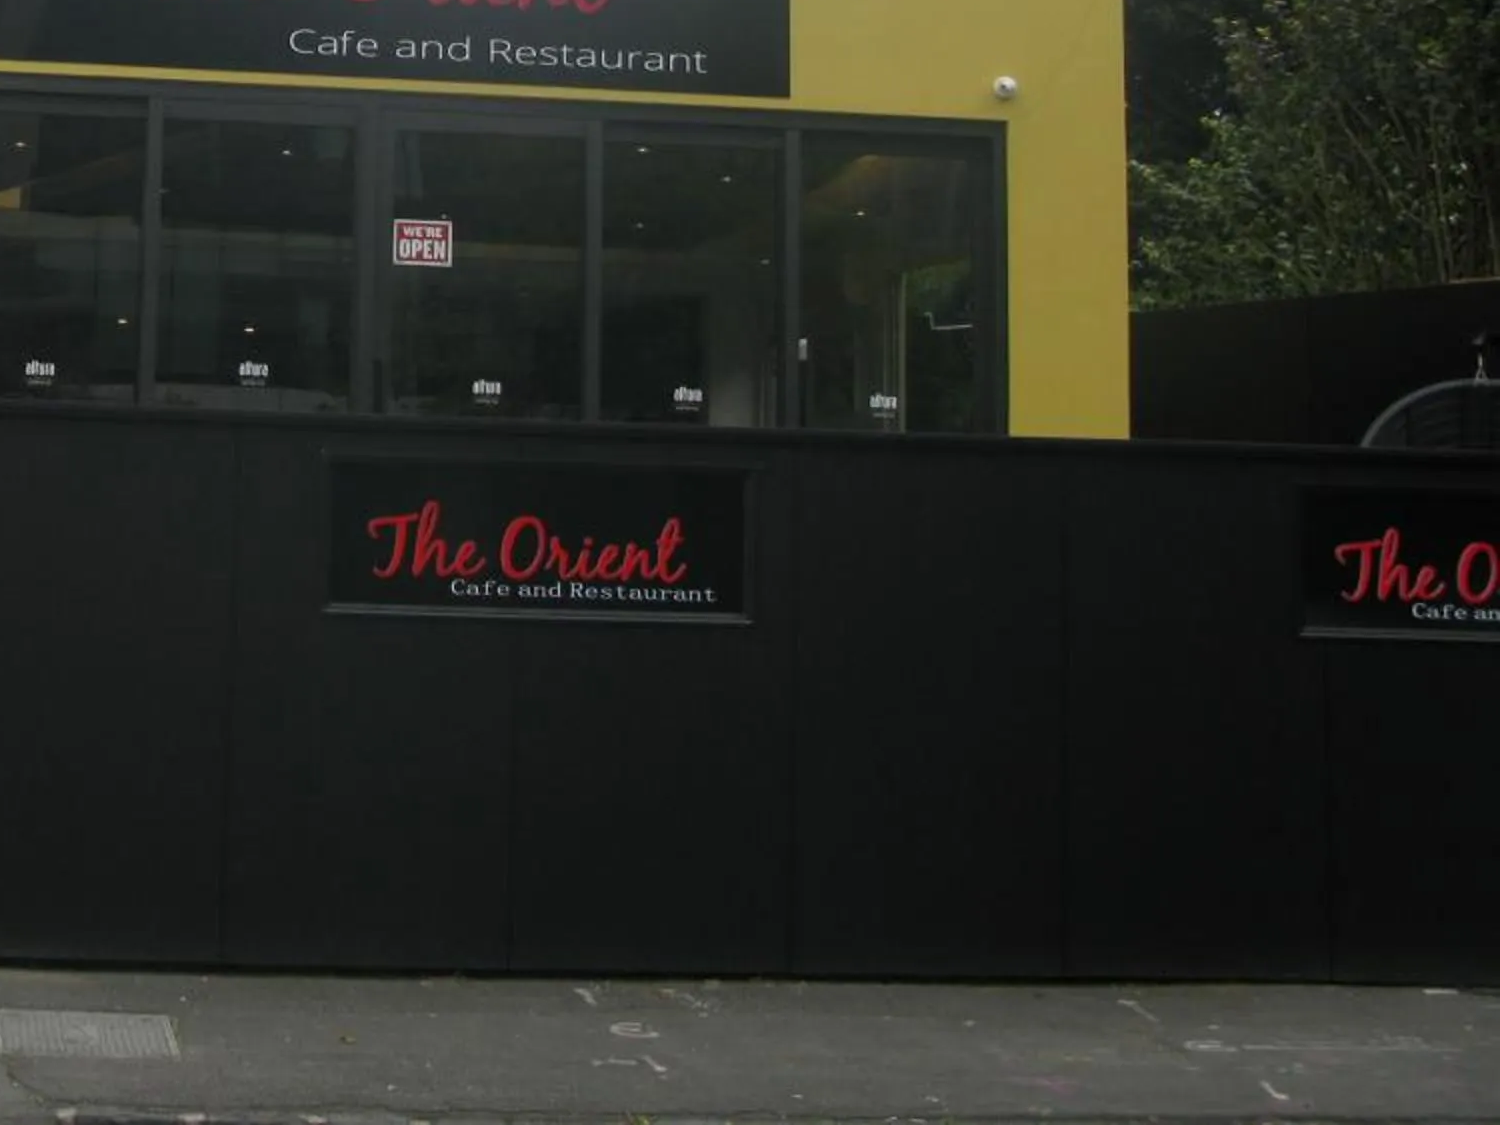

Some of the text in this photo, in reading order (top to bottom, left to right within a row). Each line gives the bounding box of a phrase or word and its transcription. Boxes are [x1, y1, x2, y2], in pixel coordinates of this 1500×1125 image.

[288, 27, 708, 75] Cafe and Restaurant
[399, 238, 446, 260] OPEN
[367, 499, 688, 584] The Orient
[1333, 526, 1447, 603] The
[450, 579, 718, 604] Cafe and Restaurant
[1411, 602, 1468, 621] Cafe
